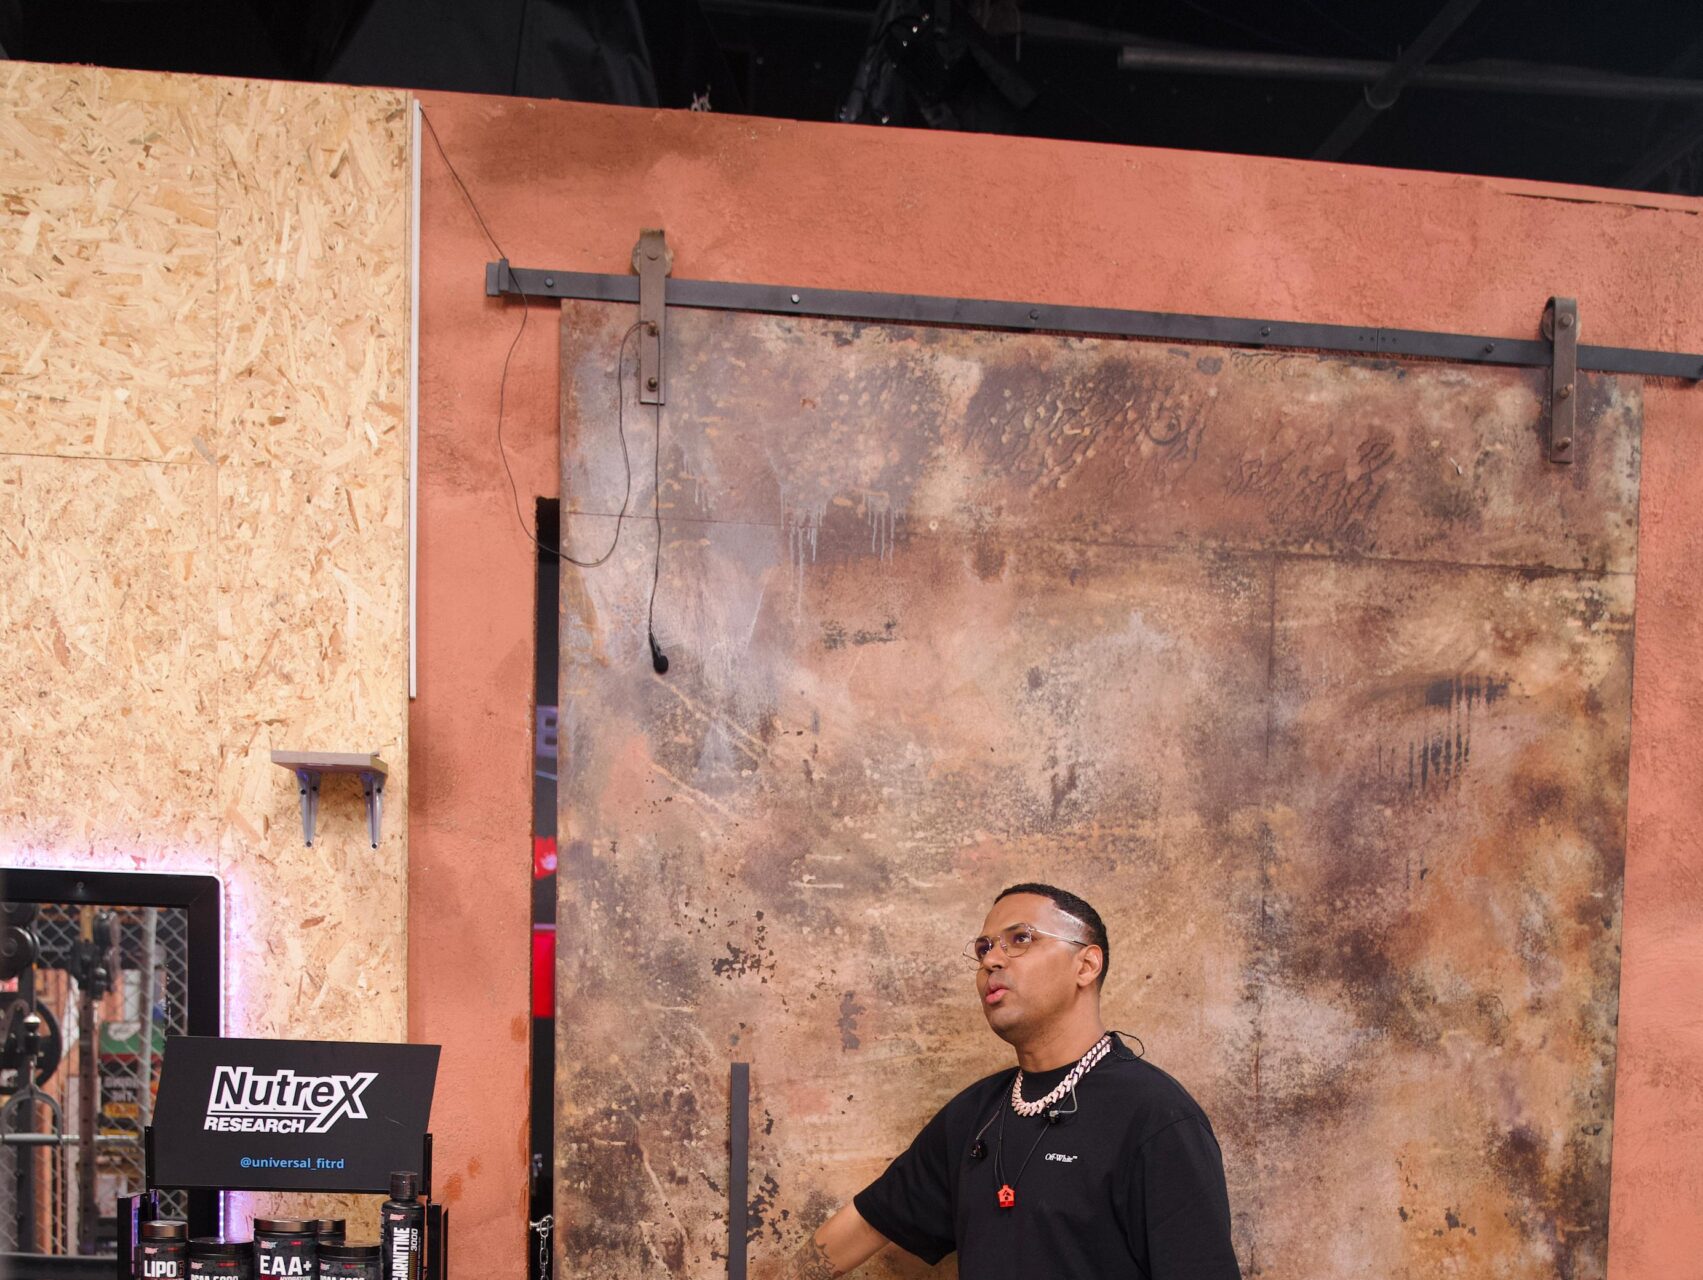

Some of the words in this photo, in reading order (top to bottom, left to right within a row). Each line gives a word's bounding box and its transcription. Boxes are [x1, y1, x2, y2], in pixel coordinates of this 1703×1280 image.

[207, 1065, 379, 1133] Nutrex
[203, 1116, 306, 1133] RESEARCH
[240, 1157, 345, 1170] @universal_fitrd
[260, 1255, 312, 1275] EAA+
